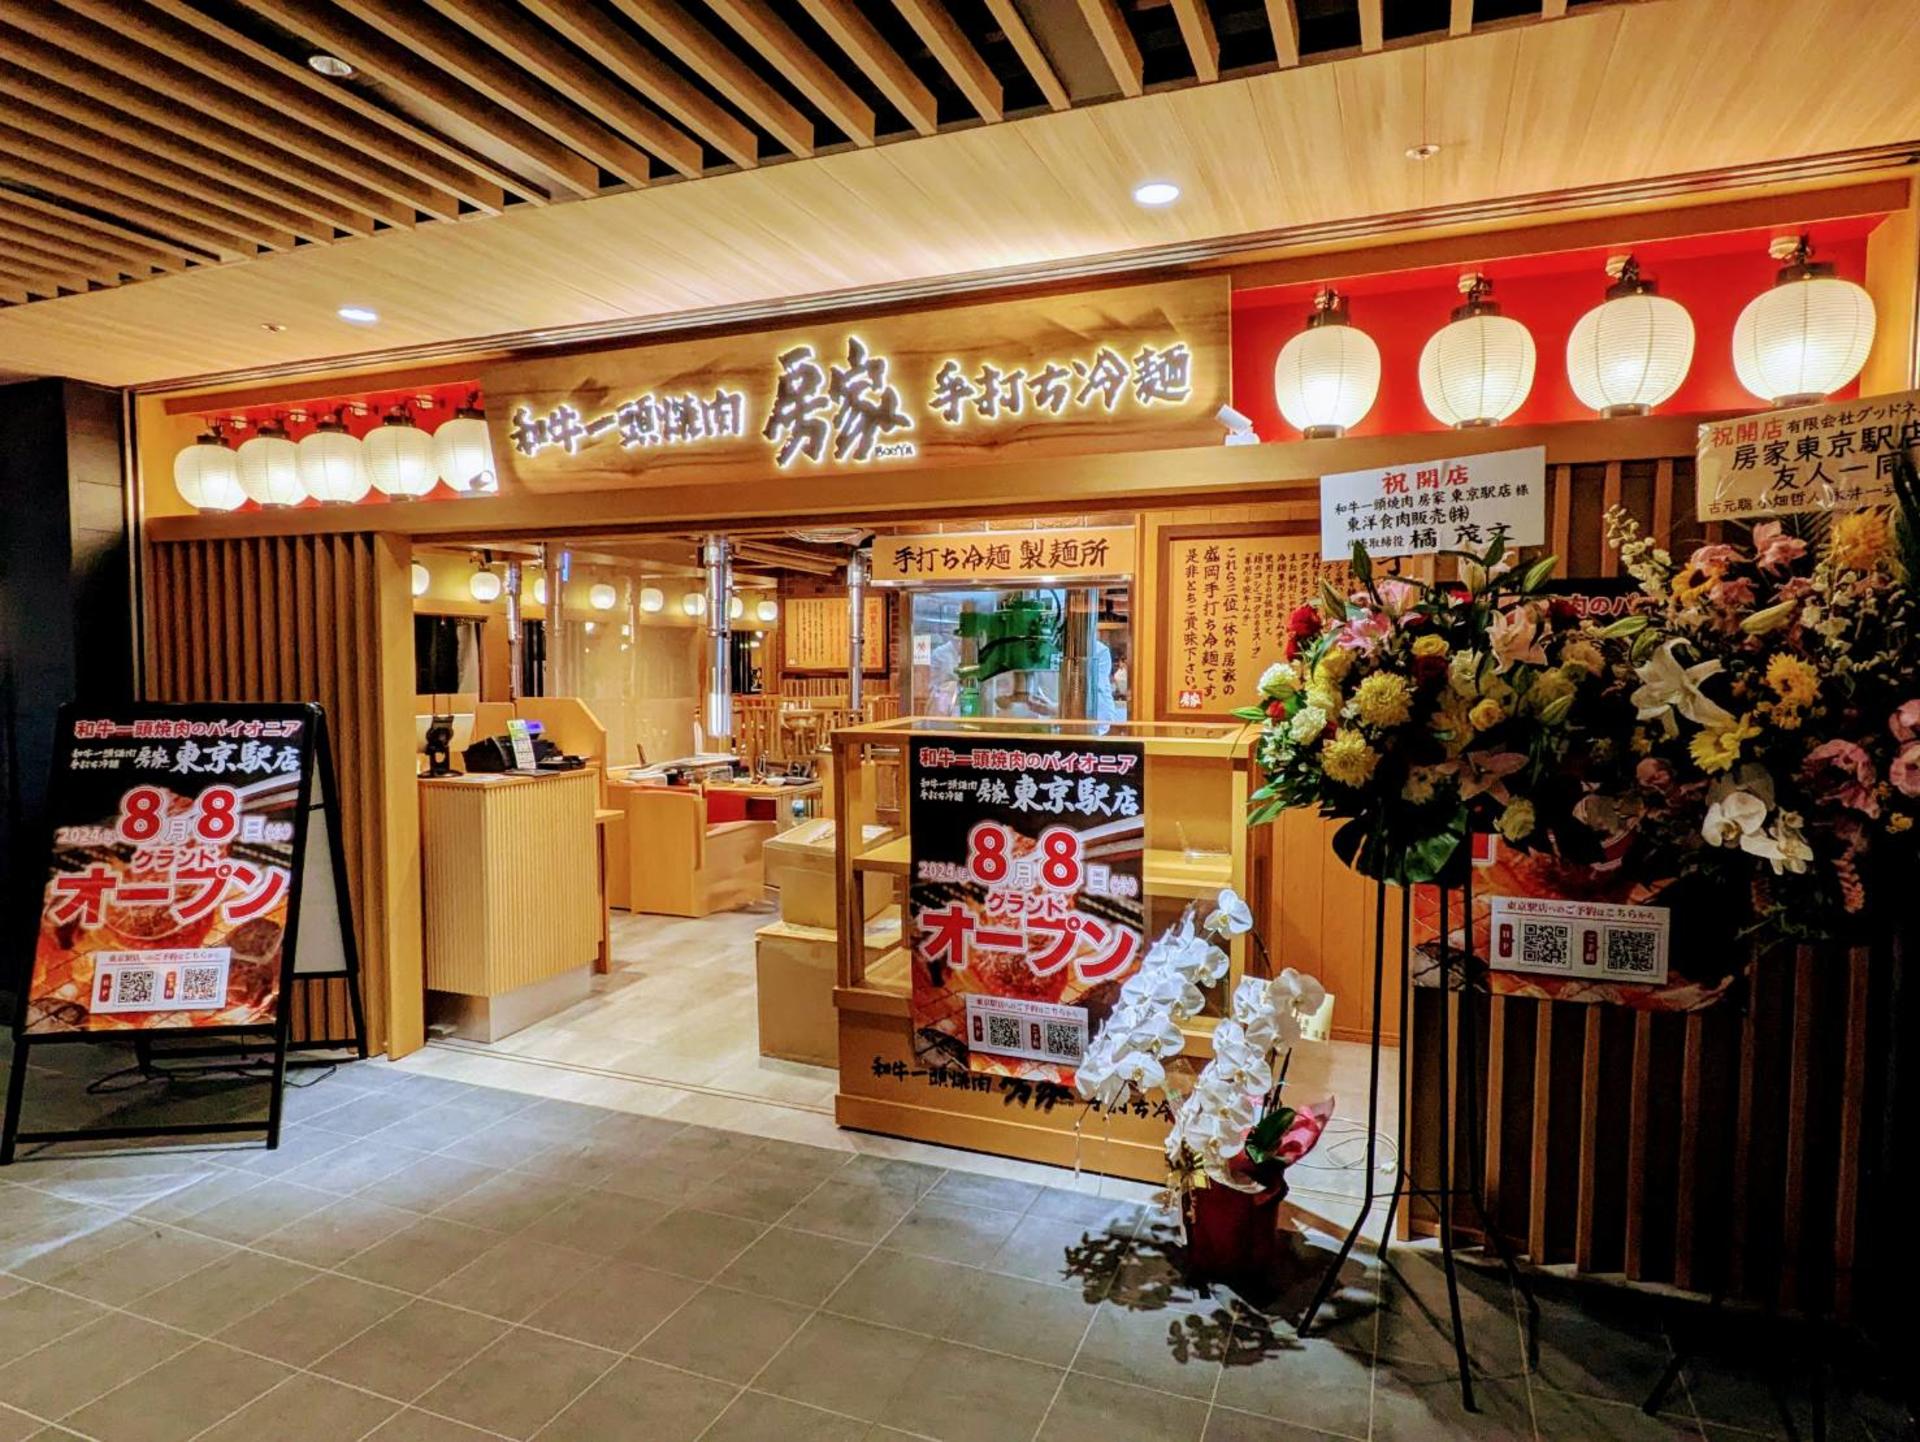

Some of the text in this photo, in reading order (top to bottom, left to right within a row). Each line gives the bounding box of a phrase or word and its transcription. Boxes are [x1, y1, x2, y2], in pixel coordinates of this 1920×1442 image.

[762, 336, 914, 467] 房家
[929, 342, 1192, 424] 手打ち冷麺
[1711, 402, 1920, 448] 祝開店 有限会社グッドネ
[1382, 464, 1469, 495] 祝開店
[1417, 490, 1446, 506] 房家
[1451, 484, 1511, 503] 東京駅店
[1515, 483, 1529, 497] 様
[893, 537, 1111, 574] 手打ち冷麺 製麺所
[75, 719, 303, 739] 和牛一頭焼肉のパイオニア
[169, 740, 301, 774] 東京駅店
[919, 747, 1138, 775] 和牛一頭焼肉のパイオニア
[1009, 774, 1140, 816] 東京駅店
[133, 848, 216, 869] グランド
[53, 864, 286, 926] オープン
[987, 892, 1066, 917] グランド
[920, 905, 1136, 979] オープン
